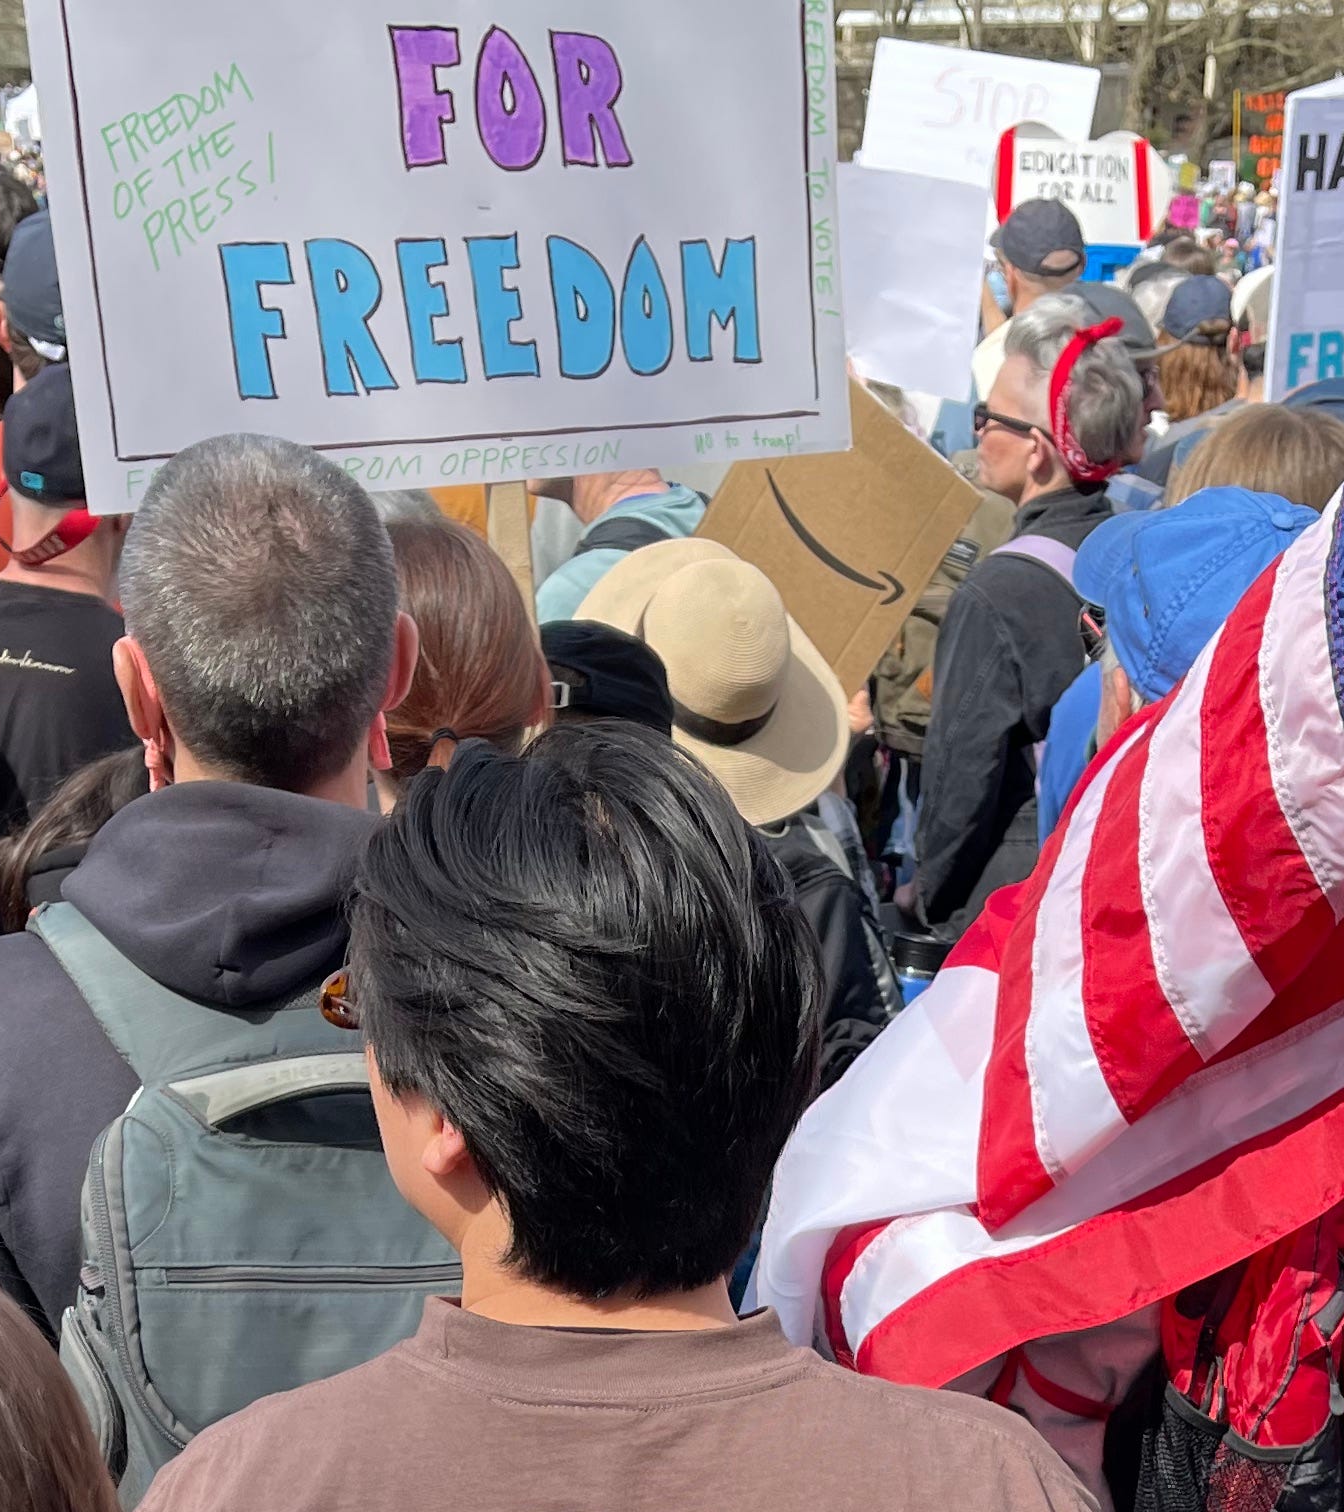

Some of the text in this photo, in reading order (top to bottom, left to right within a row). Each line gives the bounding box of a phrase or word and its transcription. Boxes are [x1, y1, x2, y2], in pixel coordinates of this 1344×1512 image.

[101, 62, 254, 173] FREEDOM
[387, 25, 634, 171] FOR
[922, 66, 1050, 128] STOP
[113, 120, 237, 220] OF THE
[143, 130, 280, 273] PRESS!
[1079, 182, 1118, 204] ALL
[218, 232, 764, 400] FREEDOM
[344, 438, 623, 482] ROM OPPRESSION
